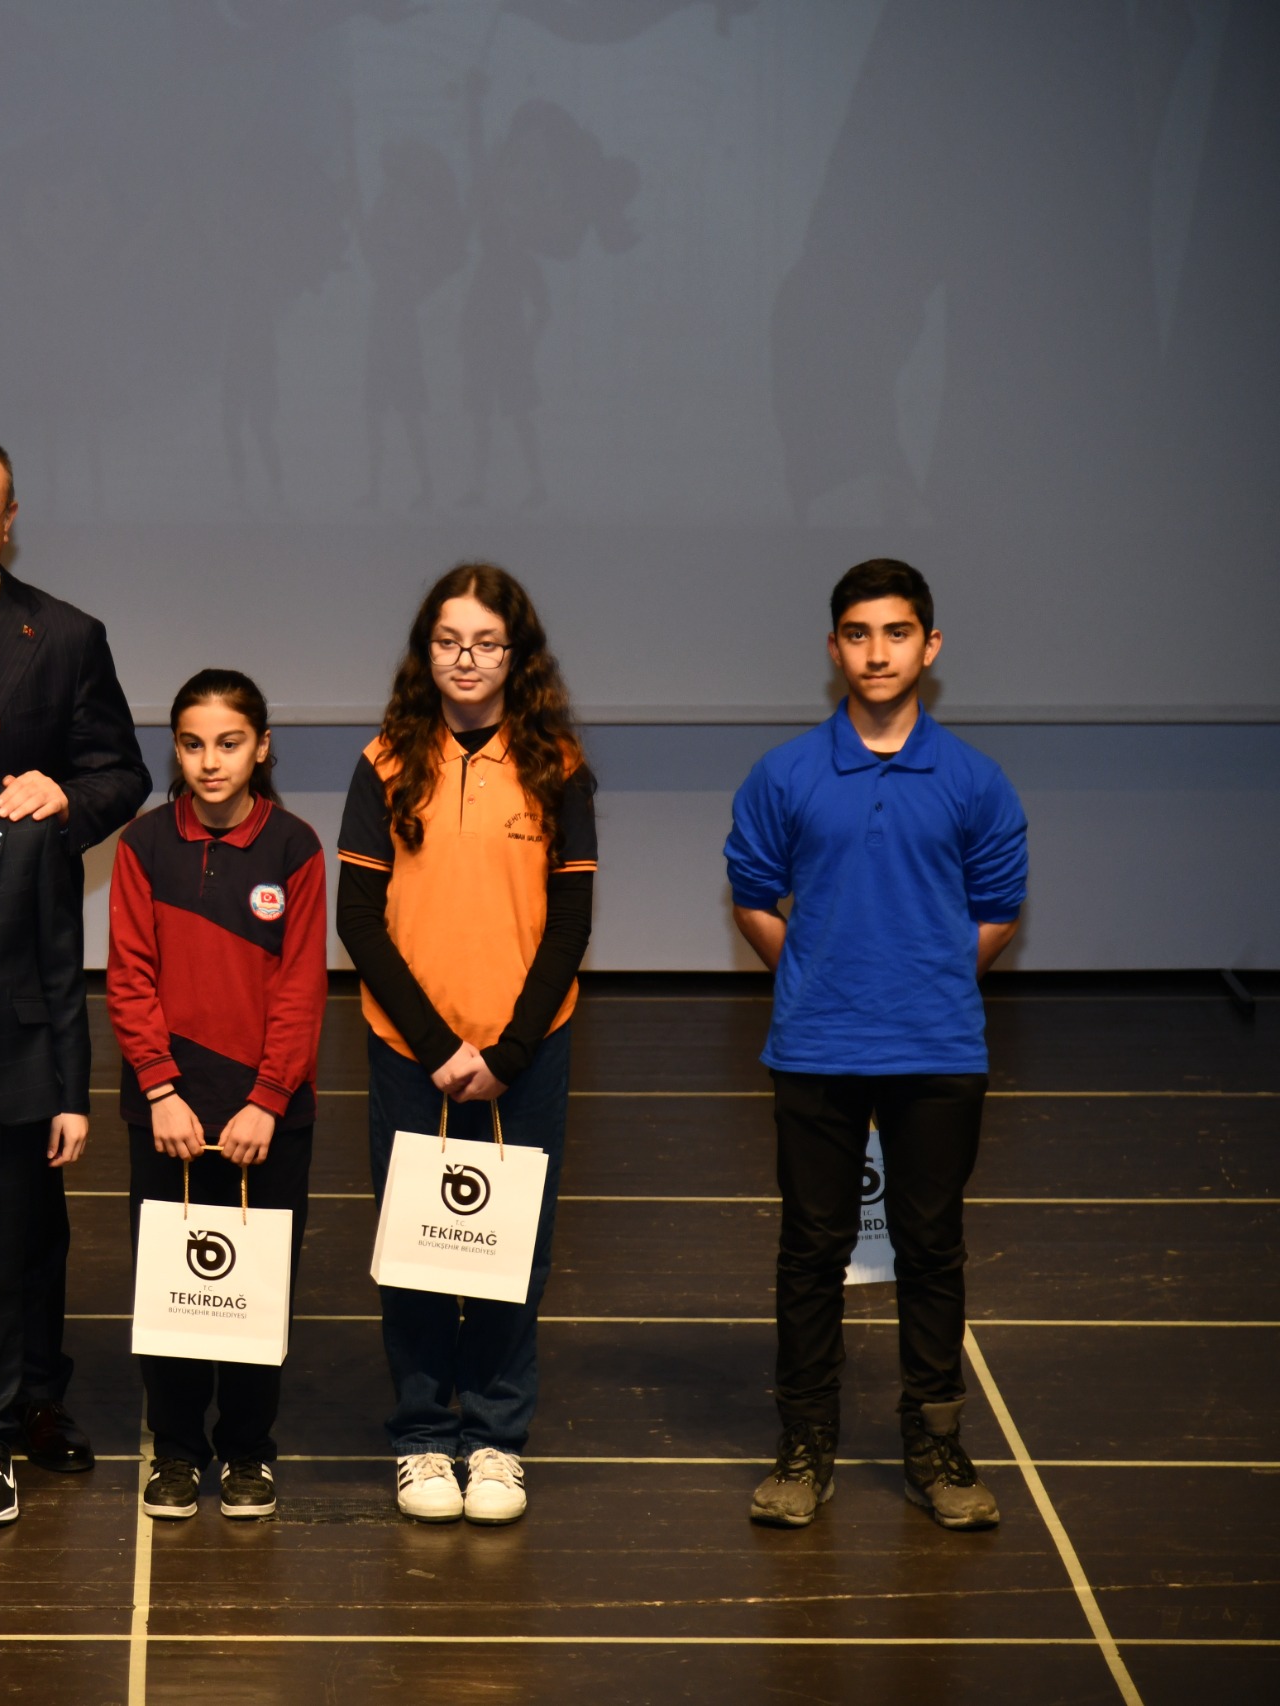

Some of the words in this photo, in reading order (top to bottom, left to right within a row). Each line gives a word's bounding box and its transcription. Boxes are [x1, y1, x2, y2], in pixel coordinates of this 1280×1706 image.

[421, 1224, 498, 1246] TEKİRDAĞ
[418, 1239, 459, 1251] BÜYÜKŞEHİR
[460, 1245, 496, 1256] BELEDİYESİ
[169, 1290, 247, 1310] TEKİRDAĞ
[168, 1306, 210, 1316] BÜYÜKŞEHİR
[211, 1310, 247, 1320] BELEDİYESİ
